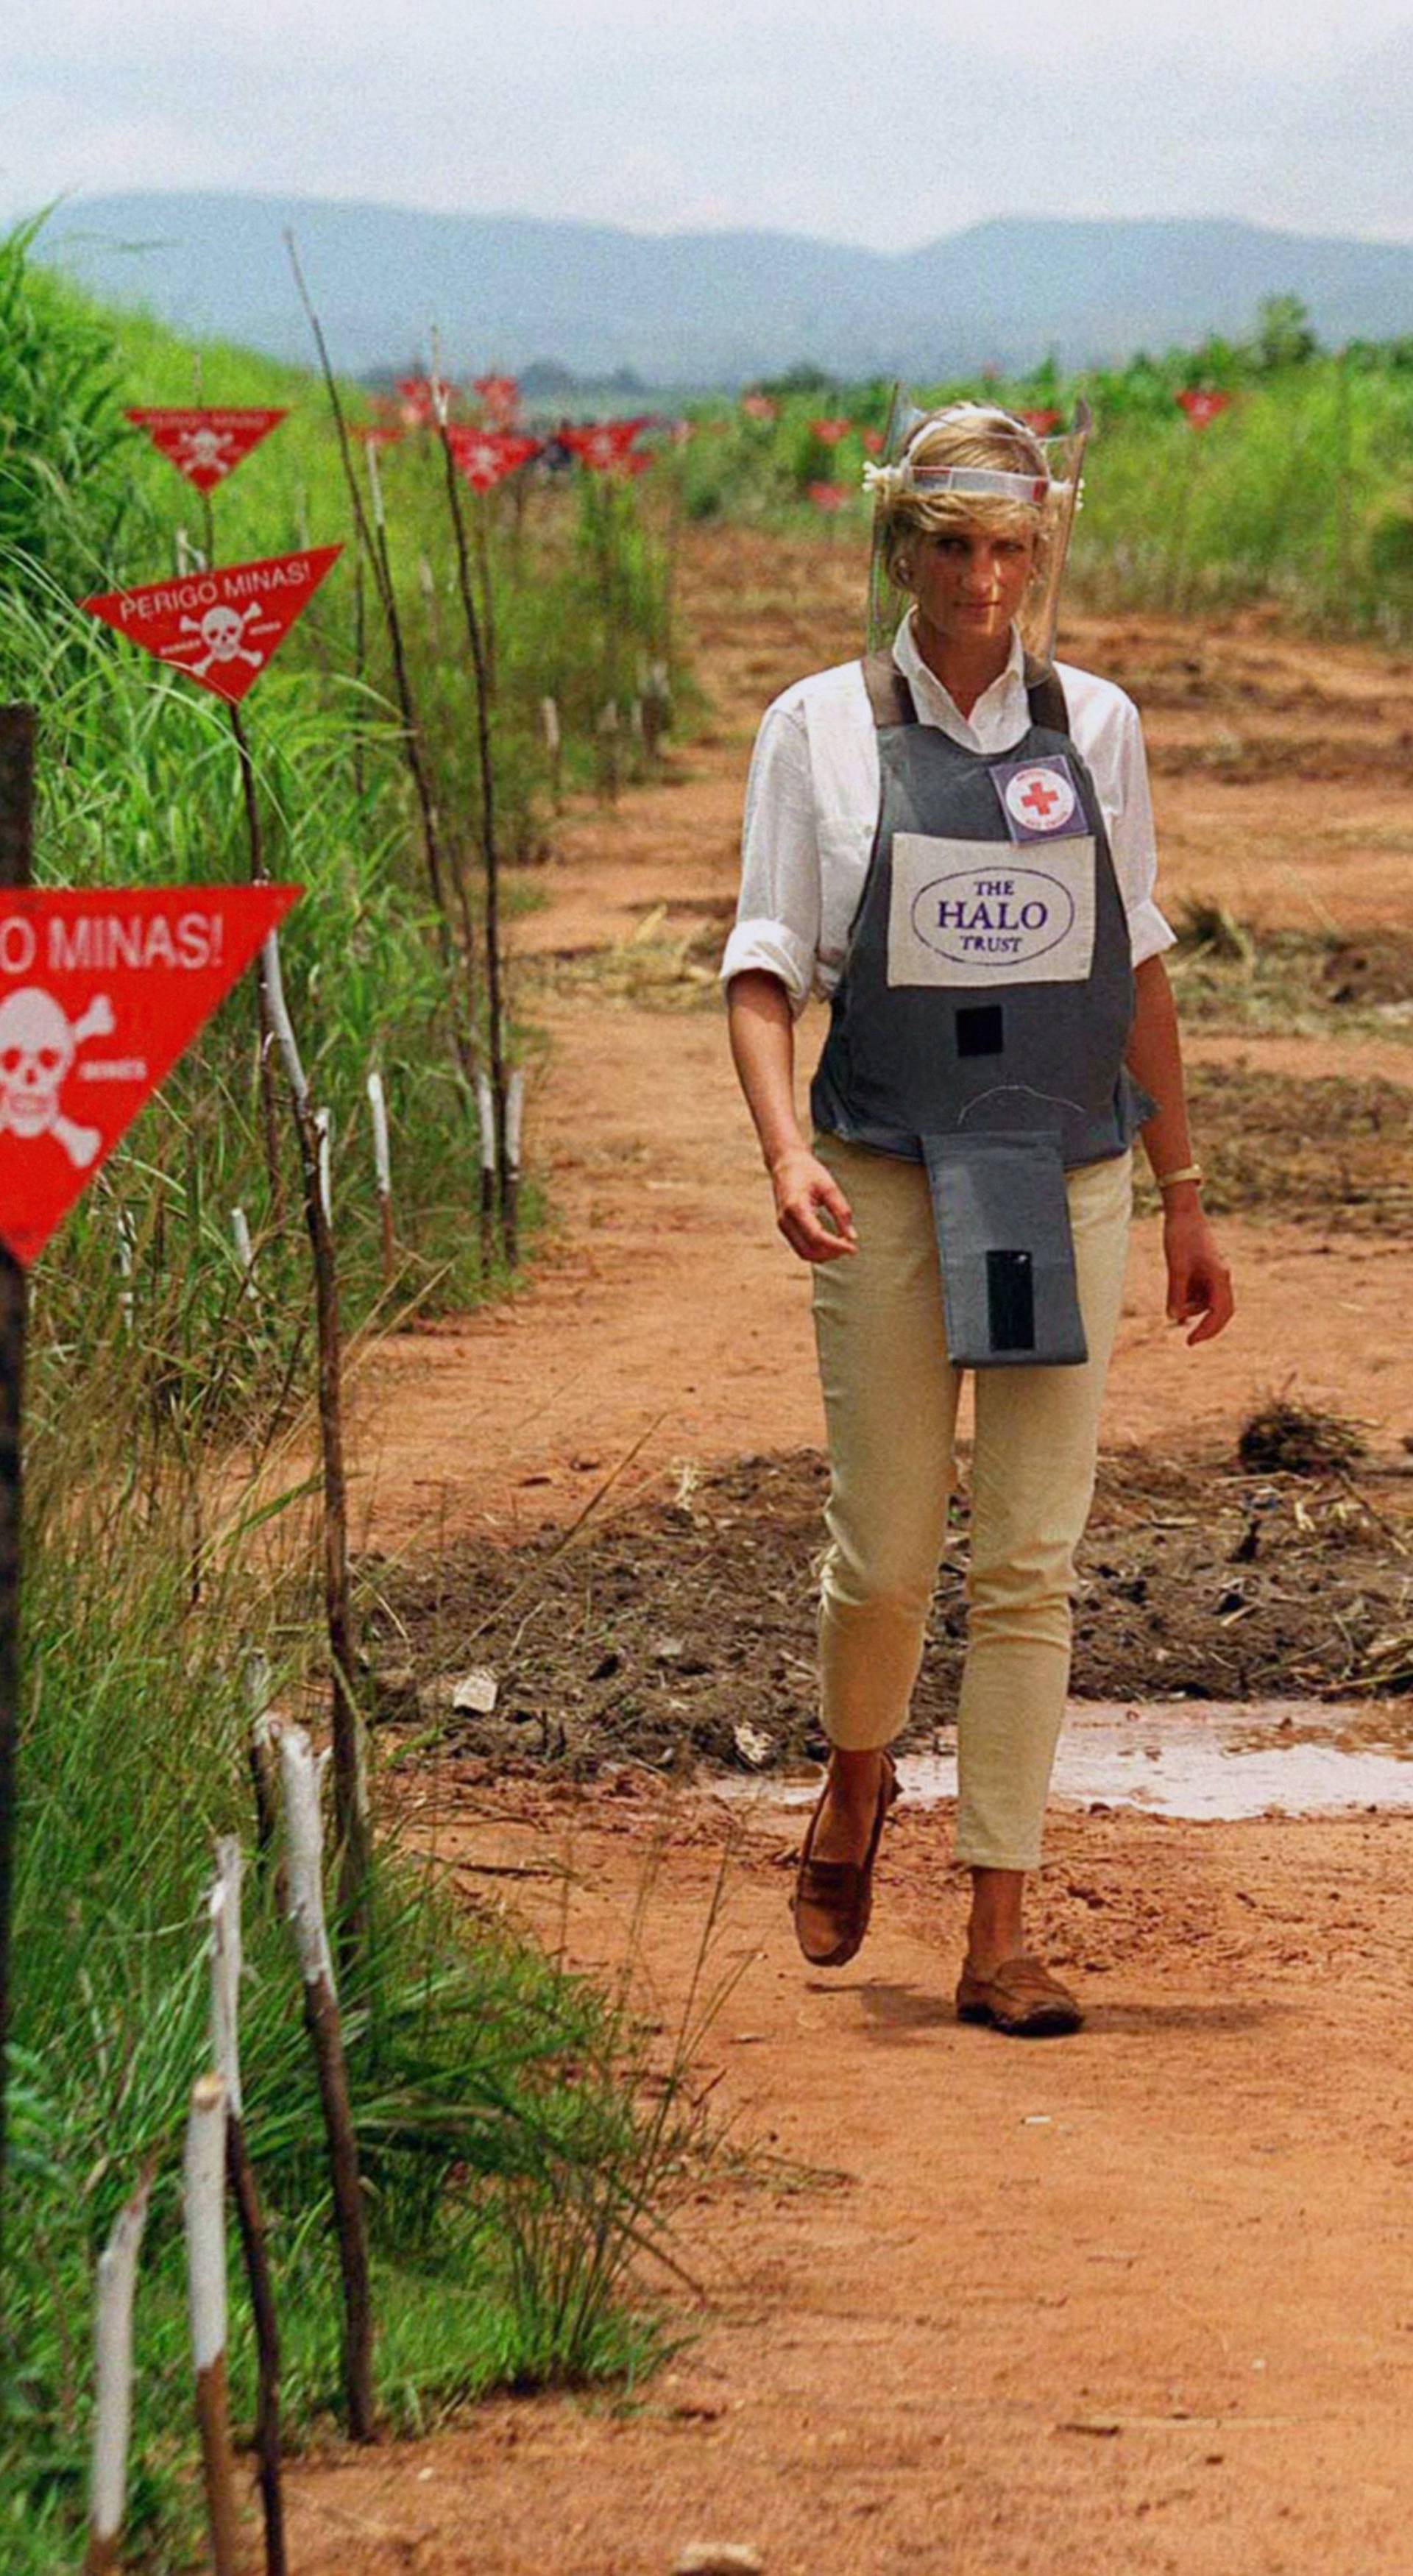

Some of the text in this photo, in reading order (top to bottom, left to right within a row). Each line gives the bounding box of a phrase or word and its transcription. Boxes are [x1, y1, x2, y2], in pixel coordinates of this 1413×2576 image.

[120, 560, 311, 622] PERIGO MINAS!
[974, 880, 1015, 896] THE
[937, 900, 1047, 930] HALO
[49, 912, 224, 970] MINAS!
[960, 935, 1022, 952] TRUST
